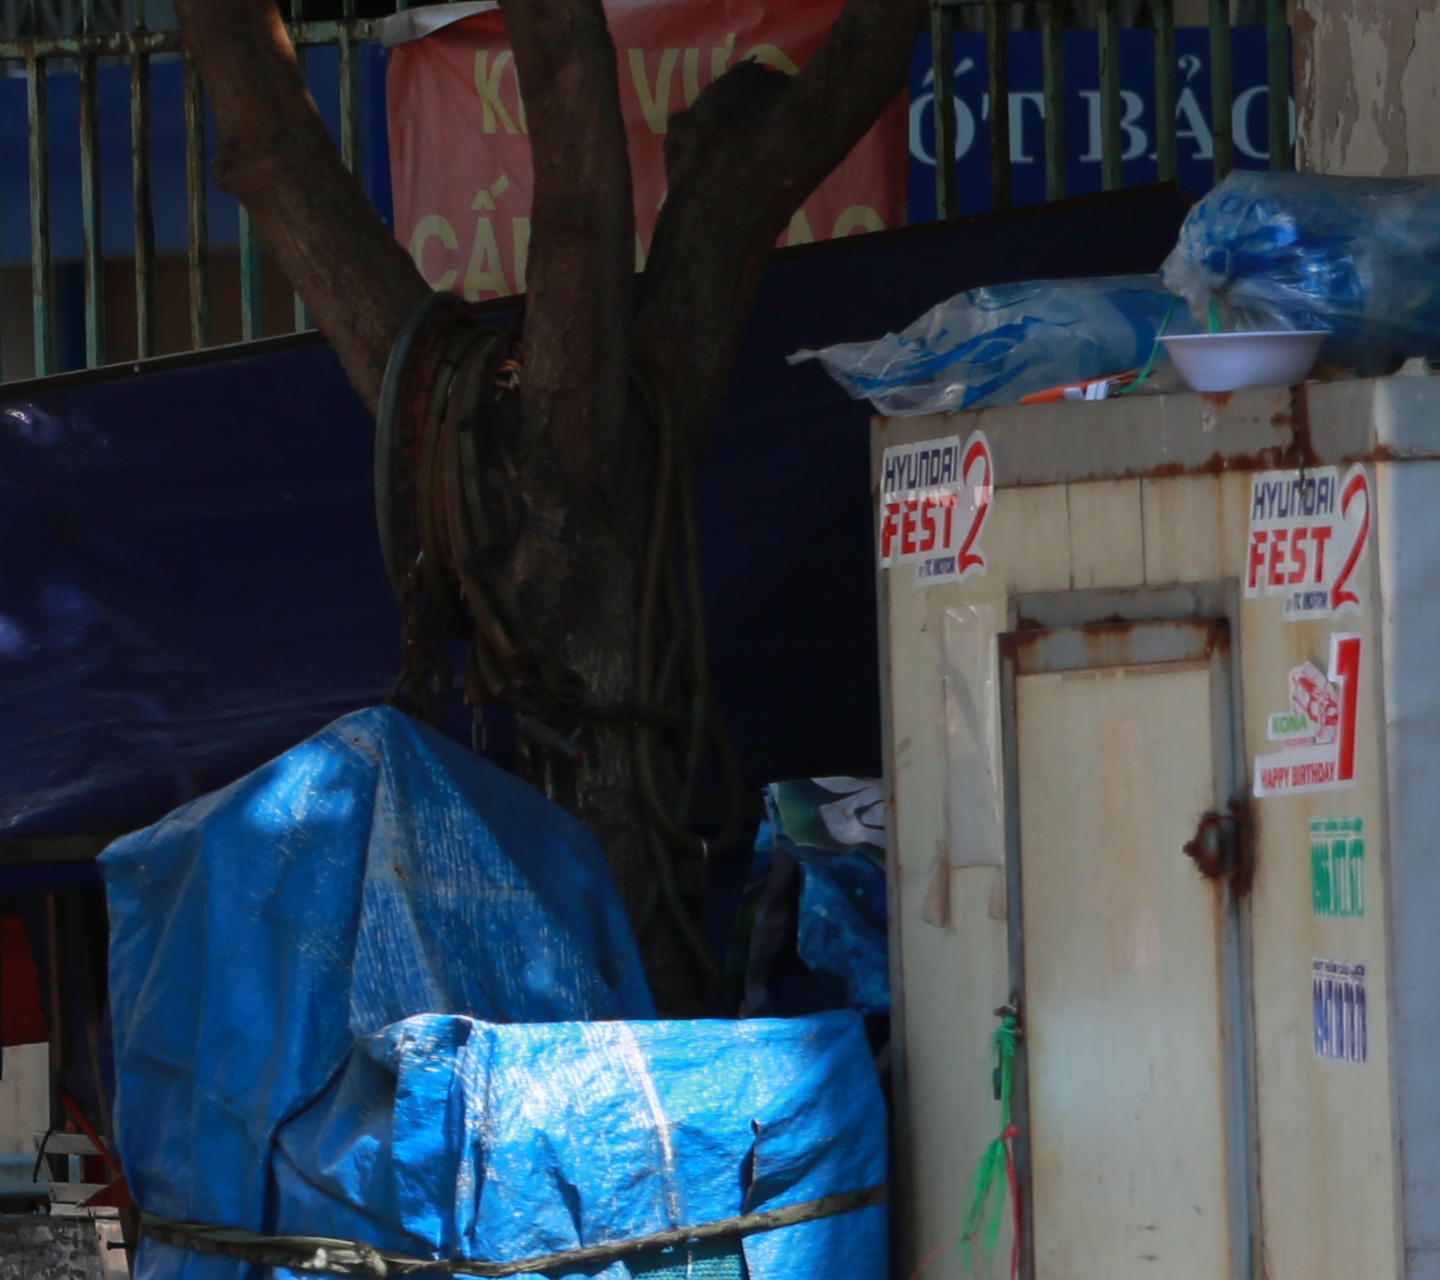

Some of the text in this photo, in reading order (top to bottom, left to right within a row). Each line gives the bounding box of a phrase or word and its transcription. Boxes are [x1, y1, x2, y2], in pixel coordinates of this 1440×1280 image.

[882, 441, 991, 574] FEST 2
[884, 446, 958, 493] HYUNDAI
[1253, 476, 1335, 519] HYUNDAI
[1248, 474, 1370, 610] FEST 2
